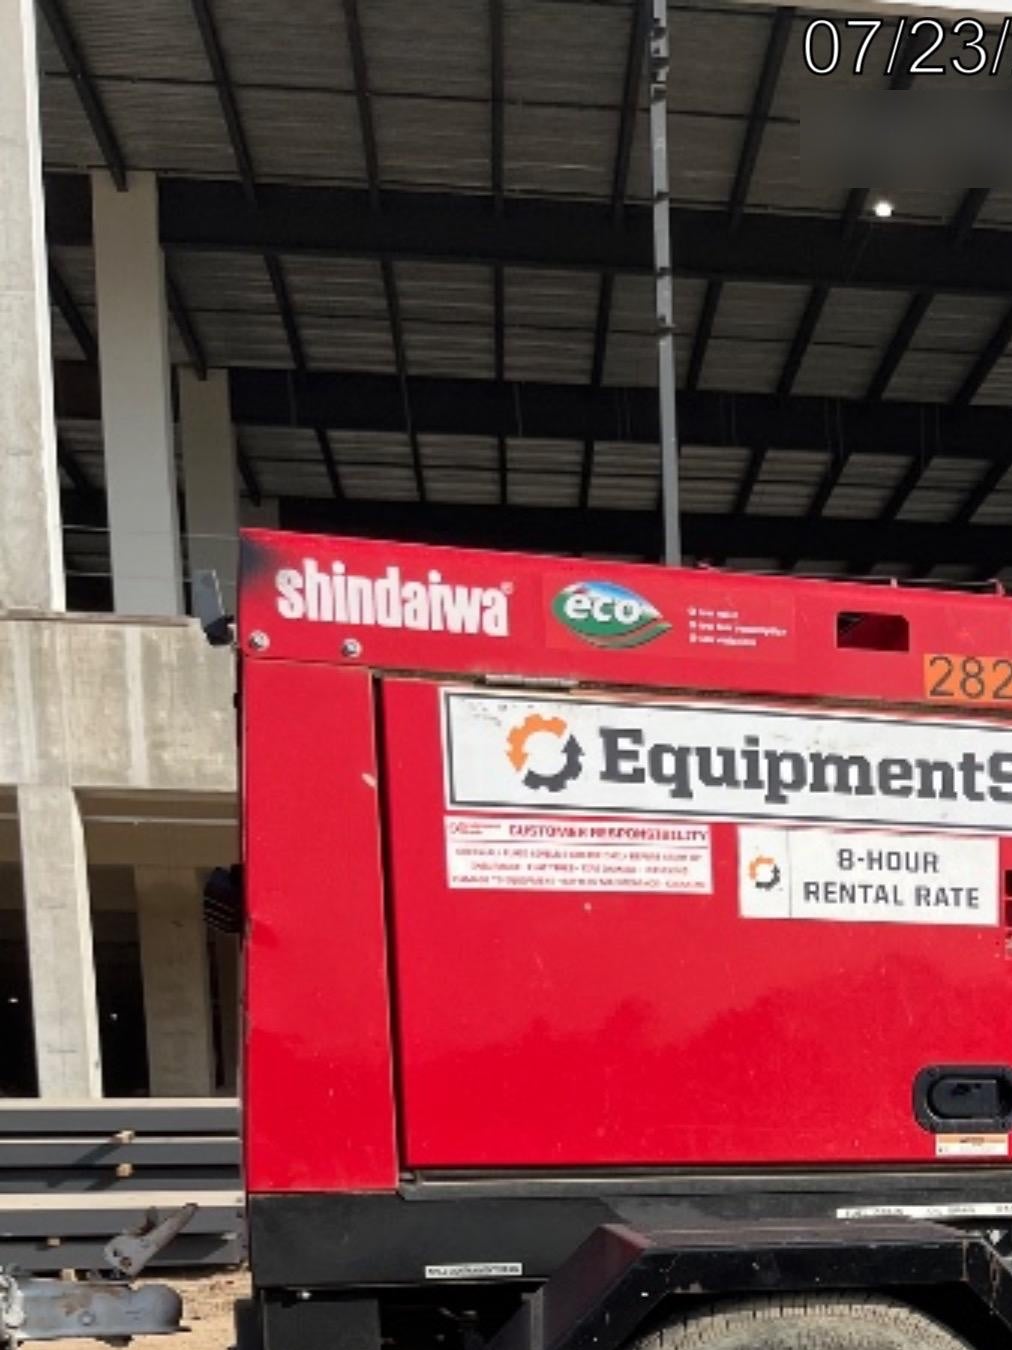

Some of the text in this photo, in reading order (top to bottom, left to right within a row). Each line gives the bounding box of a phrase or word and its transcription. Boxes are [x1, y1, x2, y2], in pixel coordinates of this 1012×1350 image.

[275, 557, 509, 637] shindaiwa
[564, 593, 642, 624] eco
[836, 847, 940, 874] 8-HOUR
[802, 880, 980, 909] RENTAL RATE
